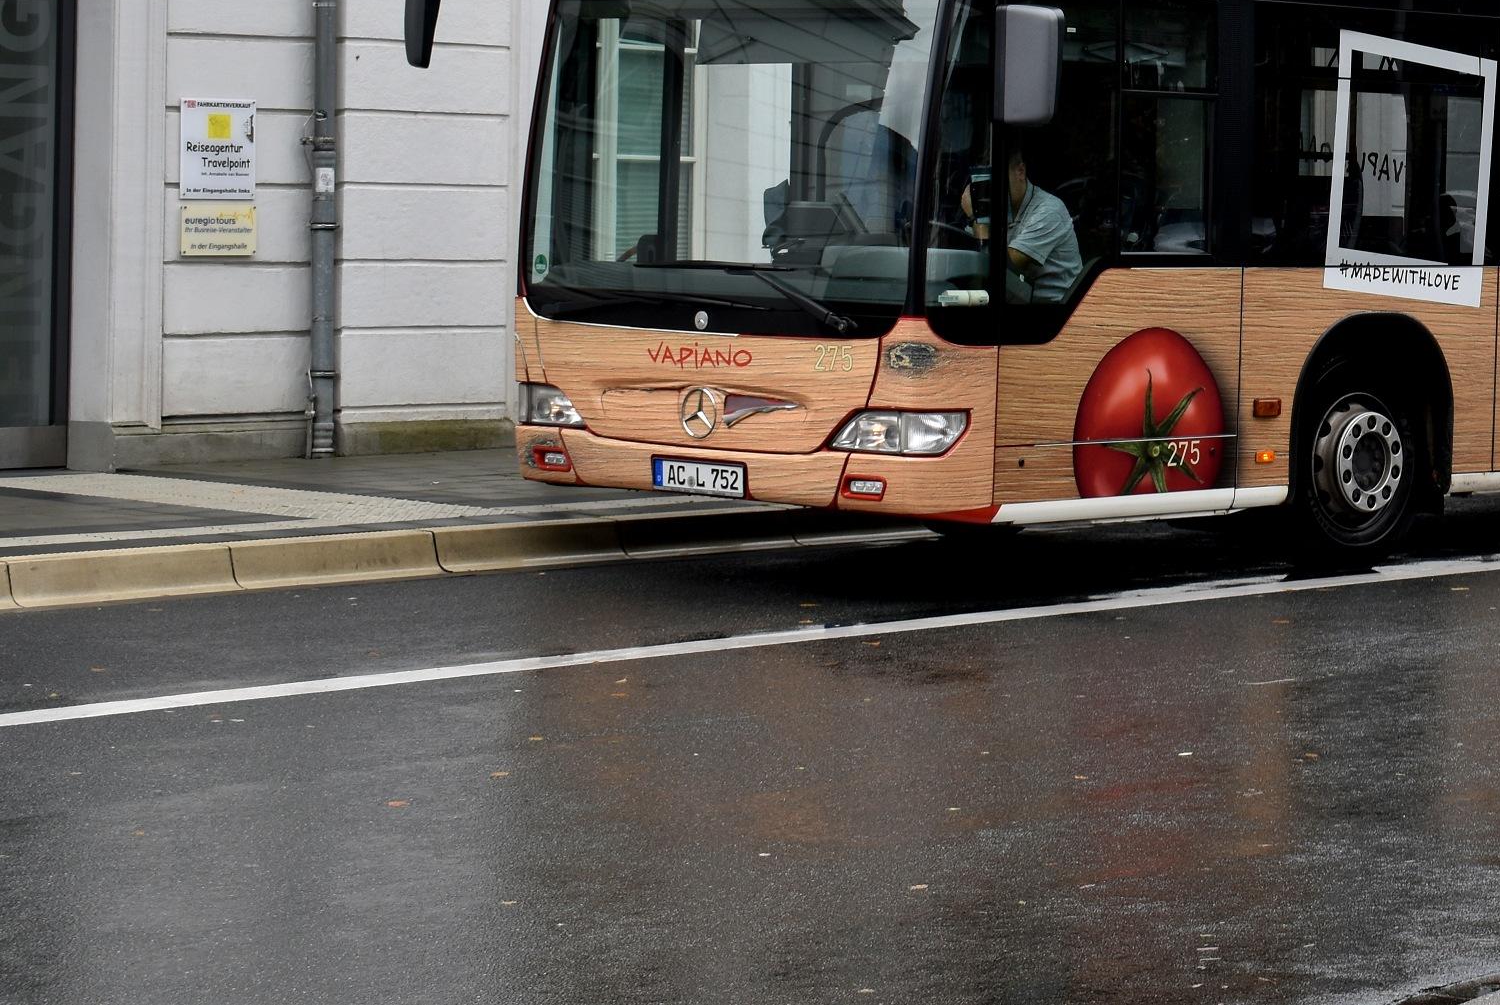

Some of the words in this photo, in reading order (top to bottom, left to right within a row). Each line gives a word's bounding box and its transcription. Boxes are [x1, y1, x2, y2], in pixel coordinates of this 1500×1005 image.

[197, 101, 251, 109] FAHRKARTENVERKAUF
[186, 141, 243, 156] Reiseagentur
[201, 157, 250, 171] Travelpoint
[208, 243, 247, 251] Eingangshalle
[1339, 259, 1460, 291] #MADEWITHLOVE
[814, 344, 853, 372] 275
[1167, 440, 1201, 467] 275
[667, 465, 686, 485] AC
[696, 467, 705, 487] L
[711, 468, 739, 491] 752
